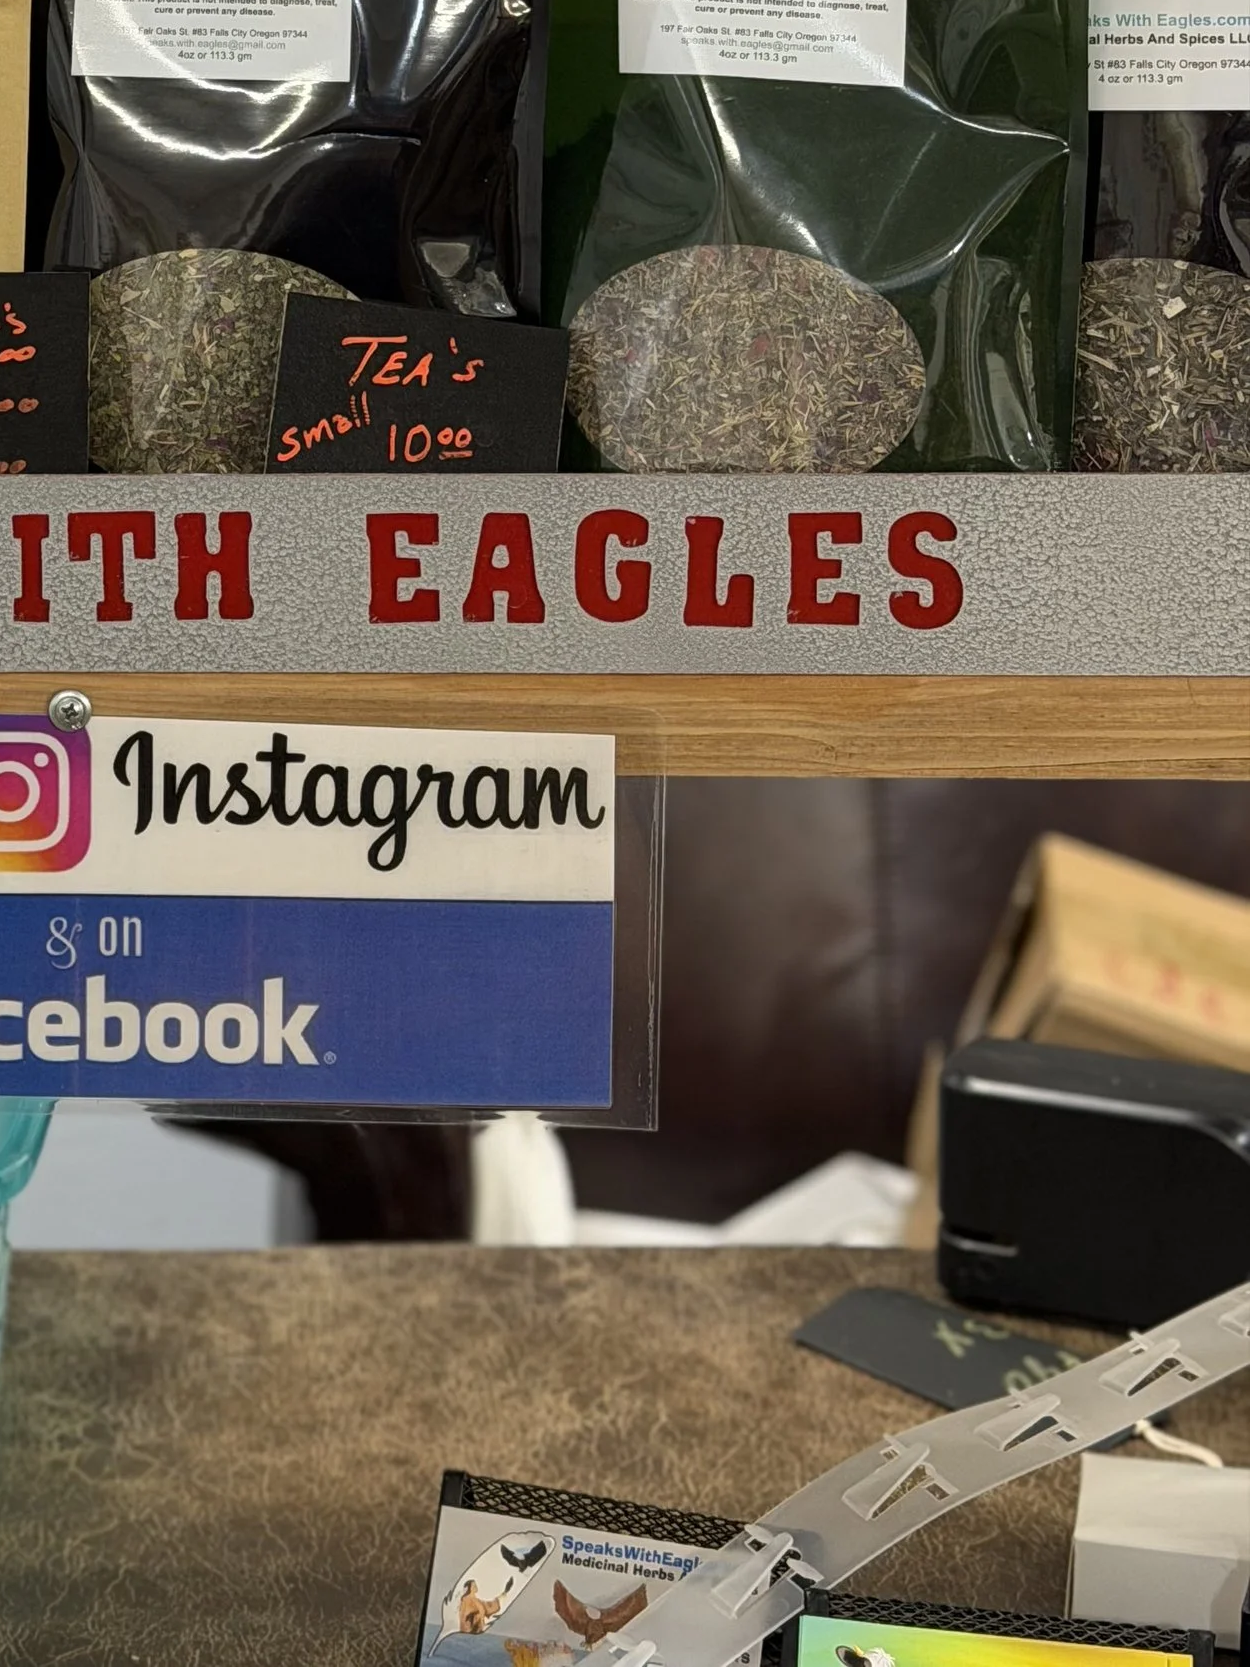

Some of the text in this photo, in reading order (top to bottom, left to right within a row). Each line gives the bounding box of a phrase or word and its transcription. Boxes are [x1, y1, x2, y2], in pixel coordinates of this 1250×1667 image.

[1105, 32, 1224, 47] Herbs And Spices
[1116, 13, 1151, 27] With
[342, 335, 484, 386] TEA's
[277, 391, 370, 461] small
[367, 508, 964, 630] EAGLES
[113, 728, 606, 871] Instagram
[99, 916, 142, 958] on
[562, 1553, 675, 1582] Medicinal Herbs
